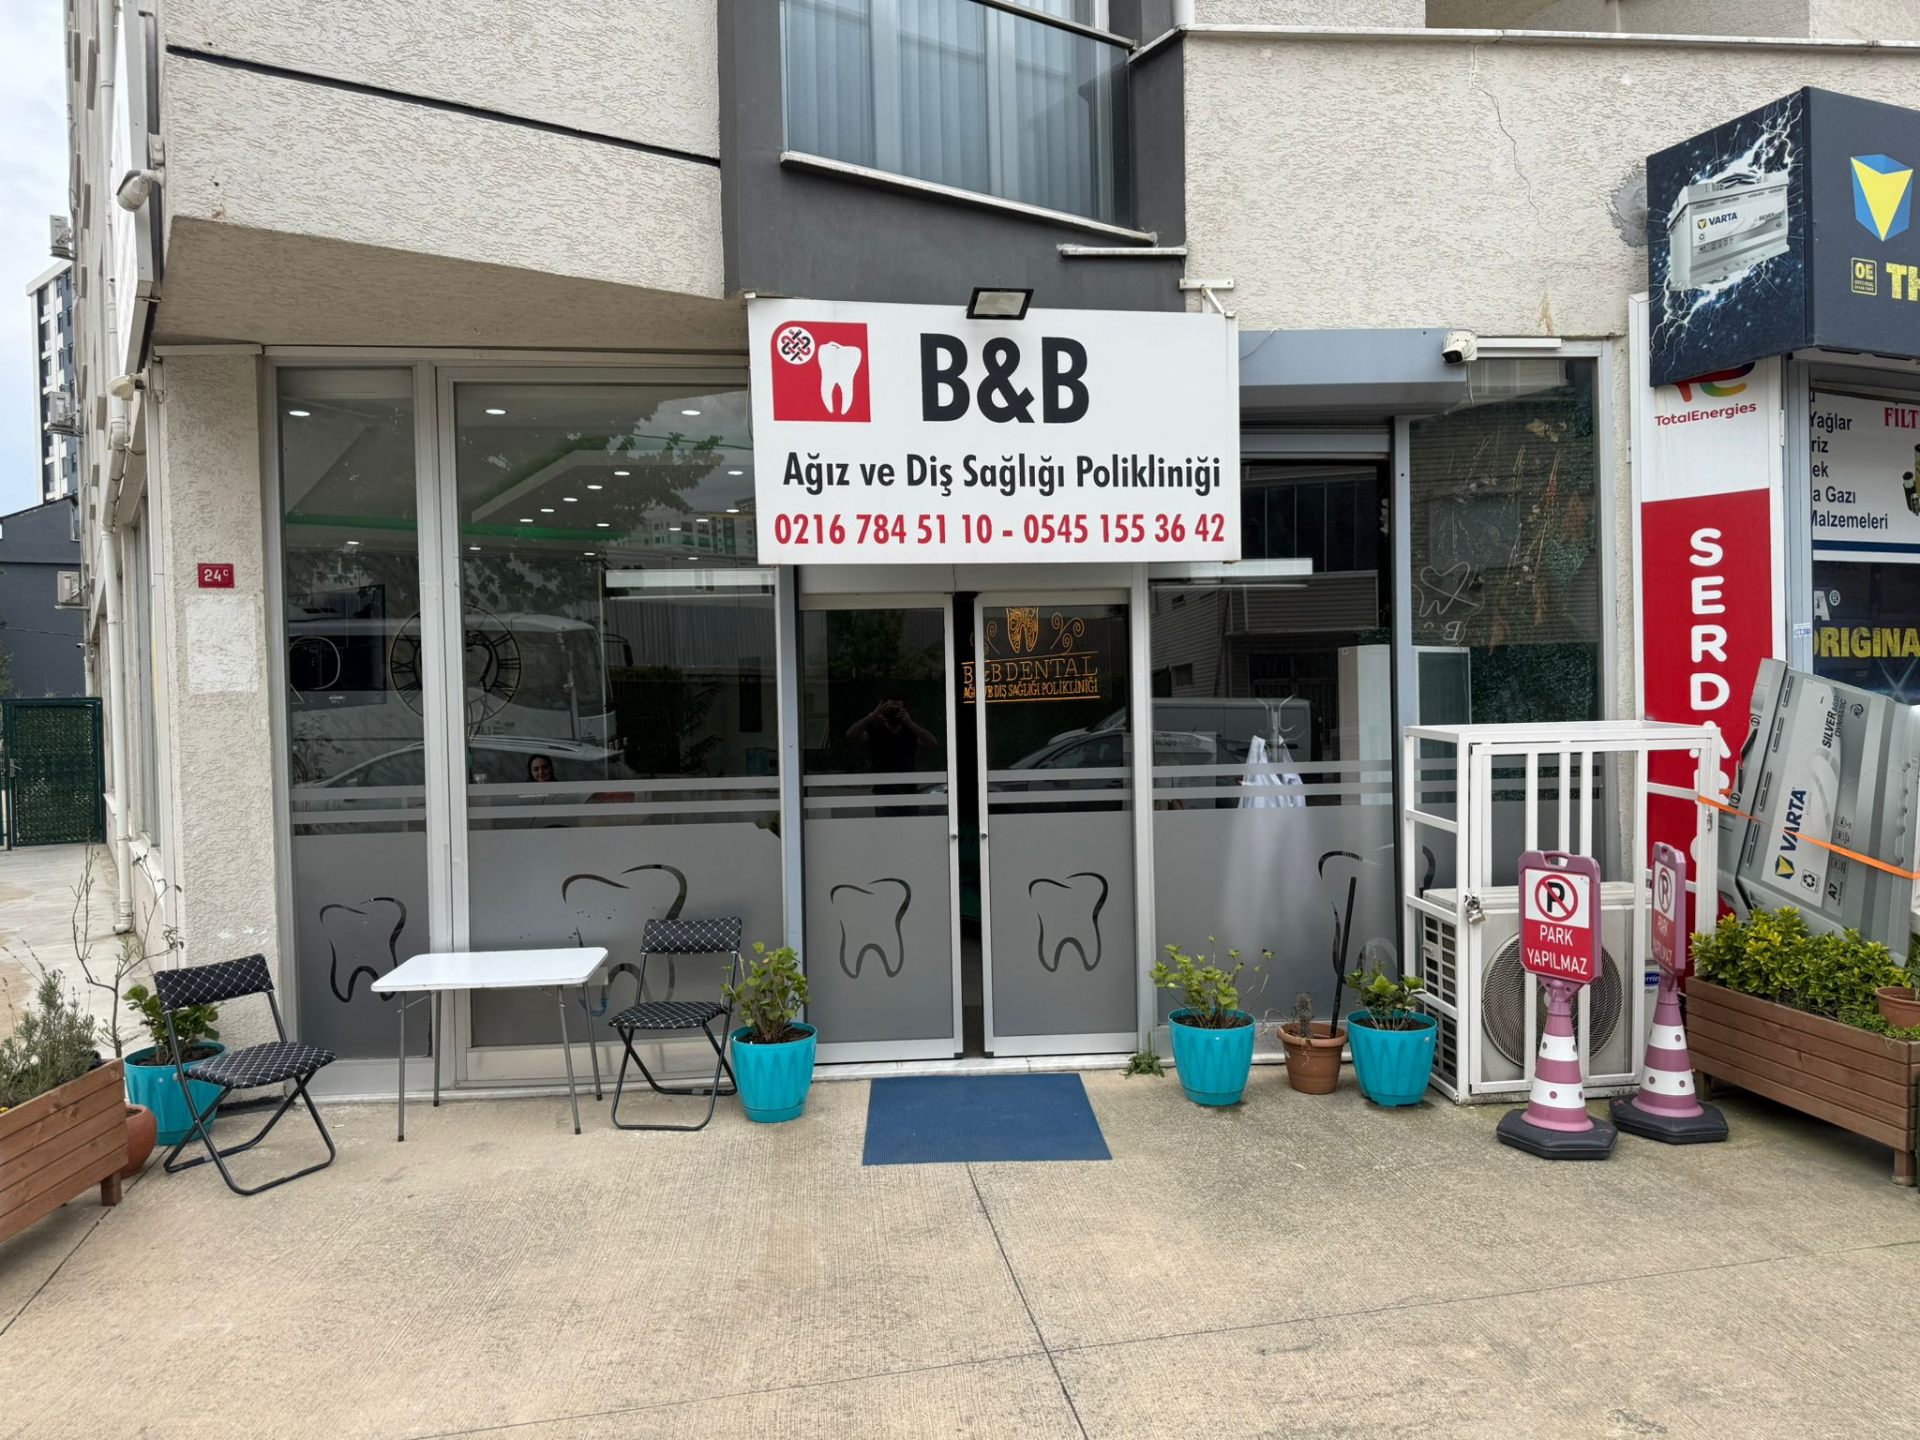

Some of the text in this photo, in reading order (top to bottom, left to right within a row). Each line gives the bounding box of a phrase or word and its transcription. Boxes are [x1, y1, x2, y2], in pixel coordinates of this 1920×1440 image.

[1708, 212, 1738, 226] VARTA
[1855, 262, 1874, 280] OE
[920, 333, 1090, 424] B&B
[1654, 403, 1757, 426] TotalEnergies
[1810, 411, 1852, 433] Yağlar
[783, 452, 1220, 496] Ağız ve Diş Sağlığı Polikliniği
[1825, 485, 1856, 504] Gazı
[774, 513, 846, 544] 0216
[856, 513, 907, 544] 784
[917, 513, 946, 544] 51
[962, 513, 993, 544] 10
[1023, 513, 1089, 544] 0545
[1100, 513, 1145, 543] 155
[1155, 513, 1186, 543] 36
[1194, 513, 1225, 543] 42
[1005, 657, 1098, 680] DENTAL
[1822, 711, 1837, 748] SILVER
[1780, 789, 1807, 851] VARTA
[1828, 883, 1838, 900] A7
[1540, 925, 1573, 946] PARK
[1527, 948, 1588, 975] YAPILMAZ
